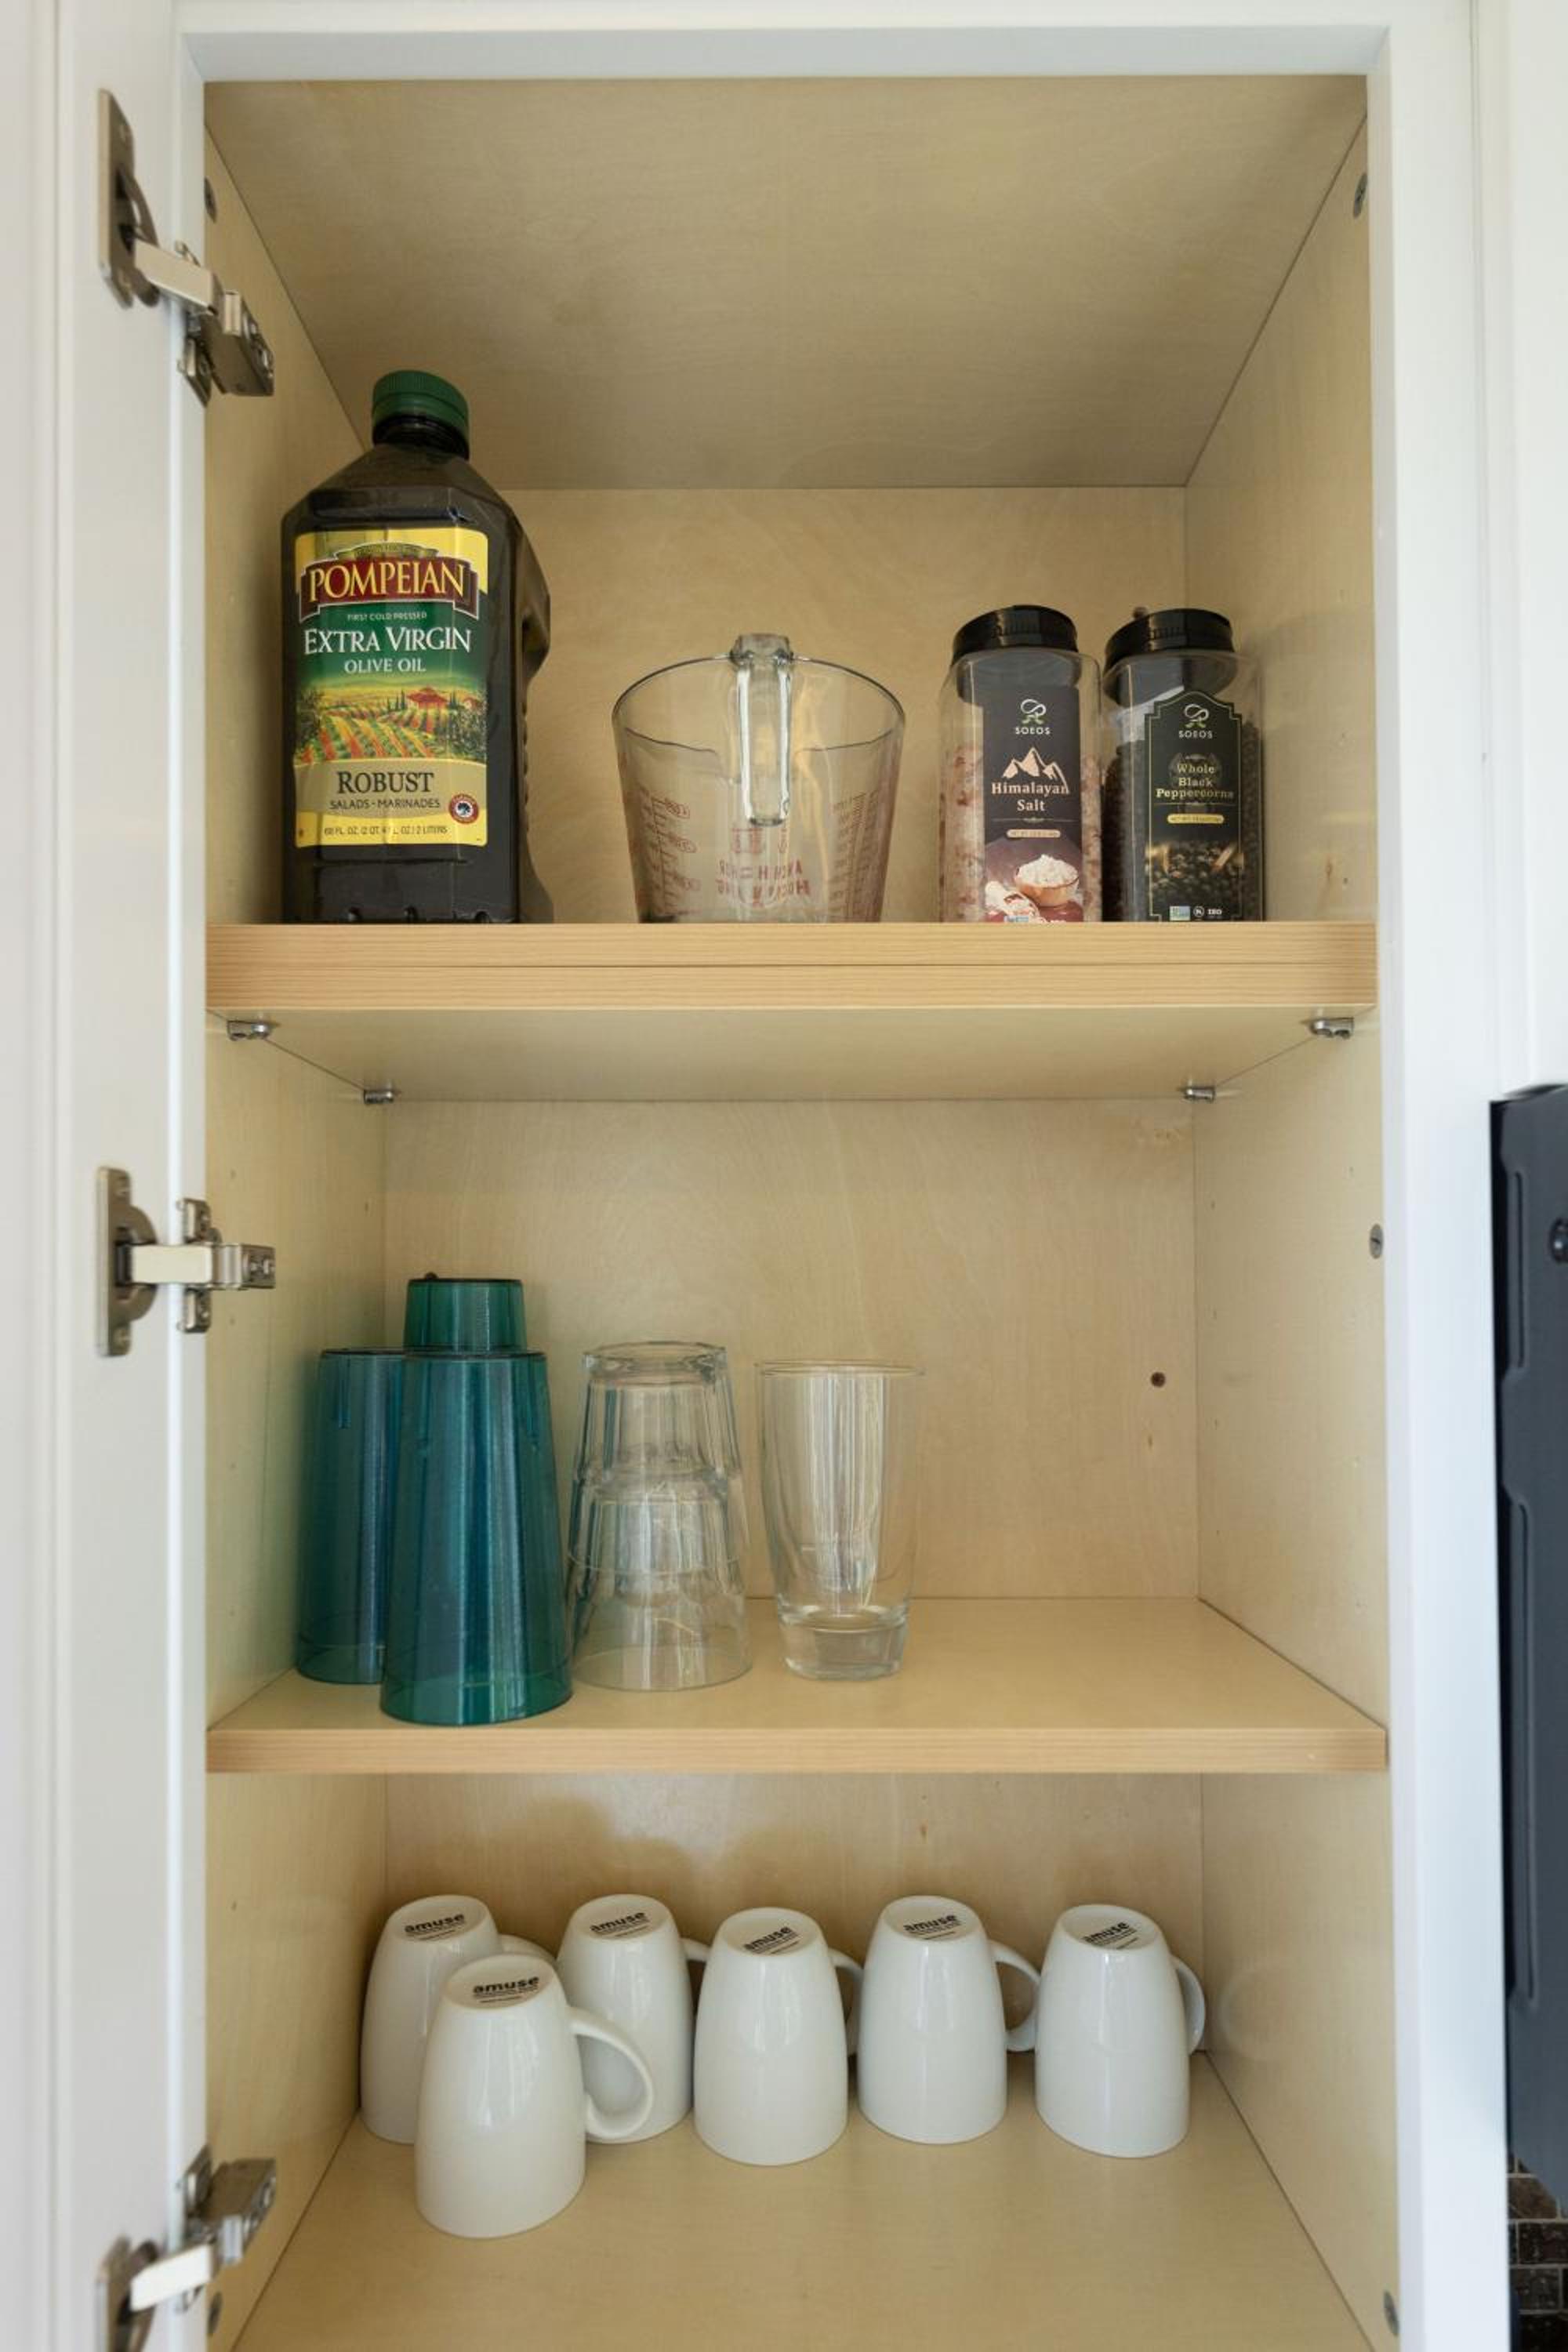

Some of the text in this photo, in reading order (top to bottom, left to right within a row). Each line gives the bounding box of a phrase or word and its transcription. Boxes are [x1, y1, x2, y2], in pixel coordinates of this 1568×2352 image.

[308, 561, 464, 603] POMPEIAN
[347, 611, 427, 622] FIRST COLD PRESSED
[304, 626, 472, 655] EXTRA VIRGIN
[344, 657, 426, 674] OLIVE OIL
[1178, 763, 1215, 775] Whole
[336, 771, 435, 794] ROBUST
[991, 782, 1070, 797] Himalayan
[1178, 777, 1214, 787] Black
[1156, 788, 1235, 800] Peppercorns
[1017, 799, 1046, 812] Salt
[404, 1913, 464, 1933] amuse
[590, 1912, 645, 1933] amuse
[904, 1915, 956, 1932] amuse
[743, 1926, 793, 1951] amuse
[1083, 1921, 1131, 1942] amuse
[473, 1976, 539, 1994] amuse
